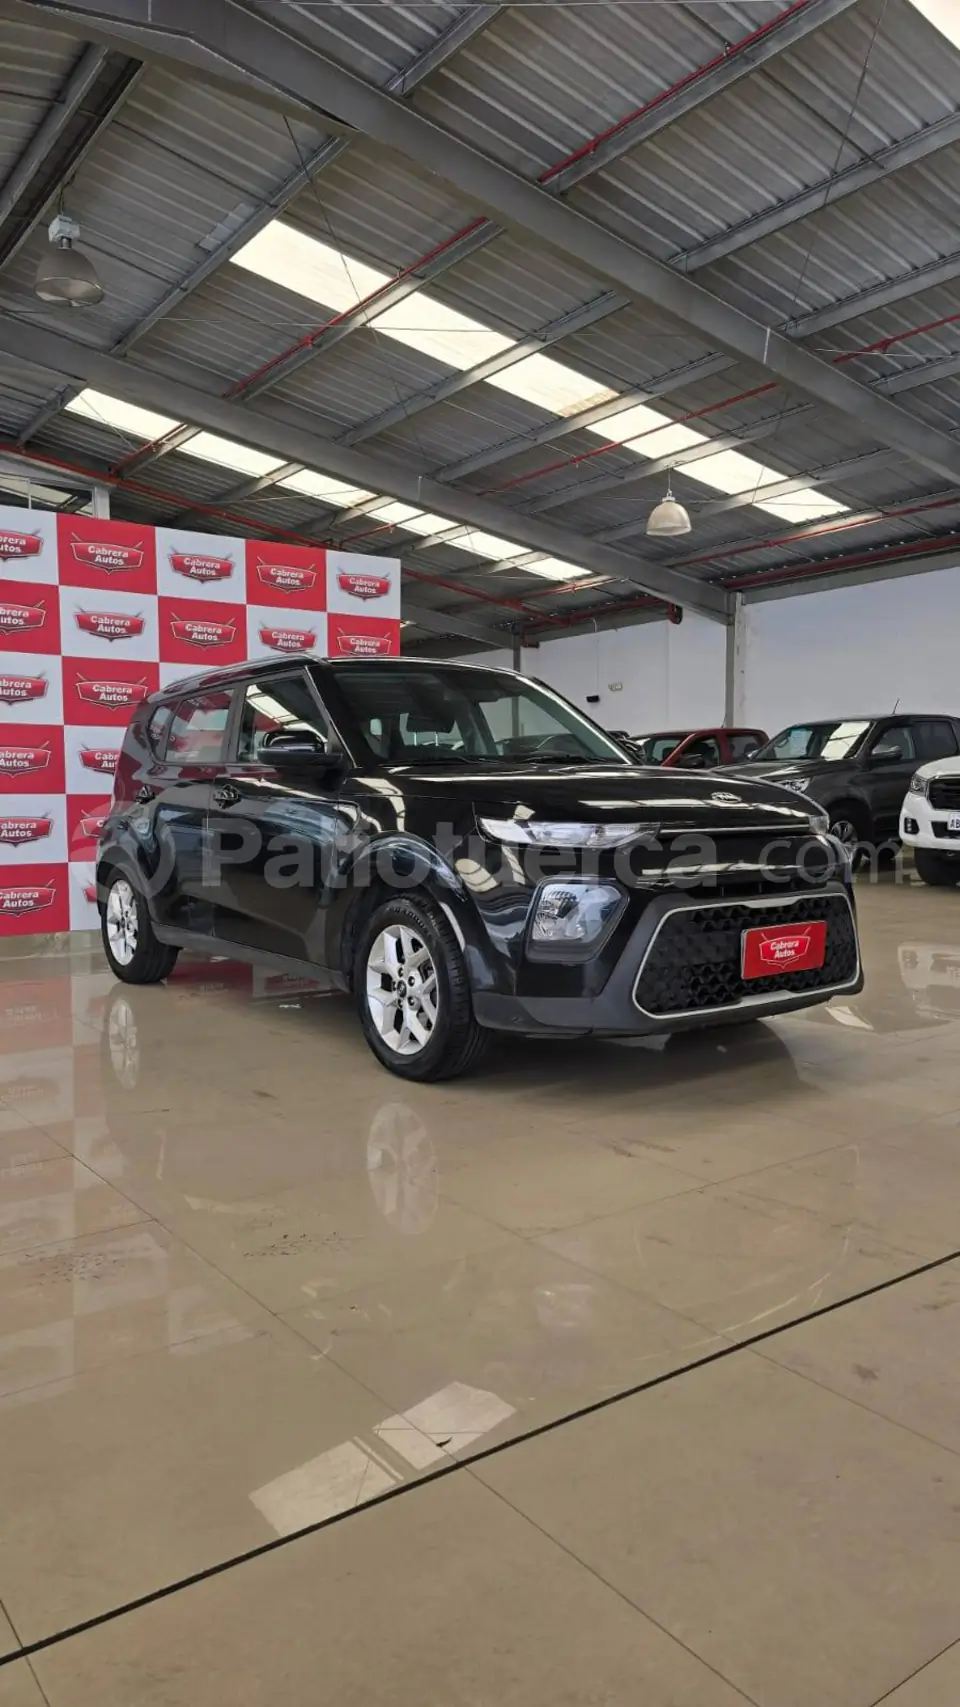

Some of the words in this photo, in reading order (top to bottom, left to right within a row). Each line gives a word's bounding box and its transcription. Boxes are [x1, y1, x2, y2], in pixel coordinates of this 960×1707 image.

[0, 536, 26, 546] rera
[88, 545, 129, 558] Cabrera
[94, 555, 124, 565] Autos
[183, 557, 220, 569] Cabrera
[189, 567, 216, 576] Autos
[270, 568, 304, 579] Cabrera
[276, 576, 300, 586] Autos
[349, 577, 380, 588] Cabrera
[354, 585, 377, 594] Autos
[0, 606, 29, 618] brera
[1, 615, 24, 625] utos
[90, 615, 131, 627] Cabrera
[97, 624, 127, 634] Autos
[185, 623, 222, 635] Cabrera
[191, 631, 218, 641] Autos
[271, 631, 305, 642] Cabrera
[277, 639, 301, 648] Autos
[349, 638, 380, 648] Cabrera
[354, 645, 377, 654] Autos
[0, 679, 31, 689] brera
[0, 687, 27, 697] utos
[92, 684, 132, 695] Cabrera
[99, 692, 128, 702] Autos
[0, 750, 34, 760] abrera
[95, 752, 119, 760] Cabr
[1, 820, 37, 830] abrera
[1, 828, 32, 838] Autos
[3, 898, 34, 908] Autos
[770, 940, 800, 951] Cabrera
[774, 949, 796, 959] Autos
